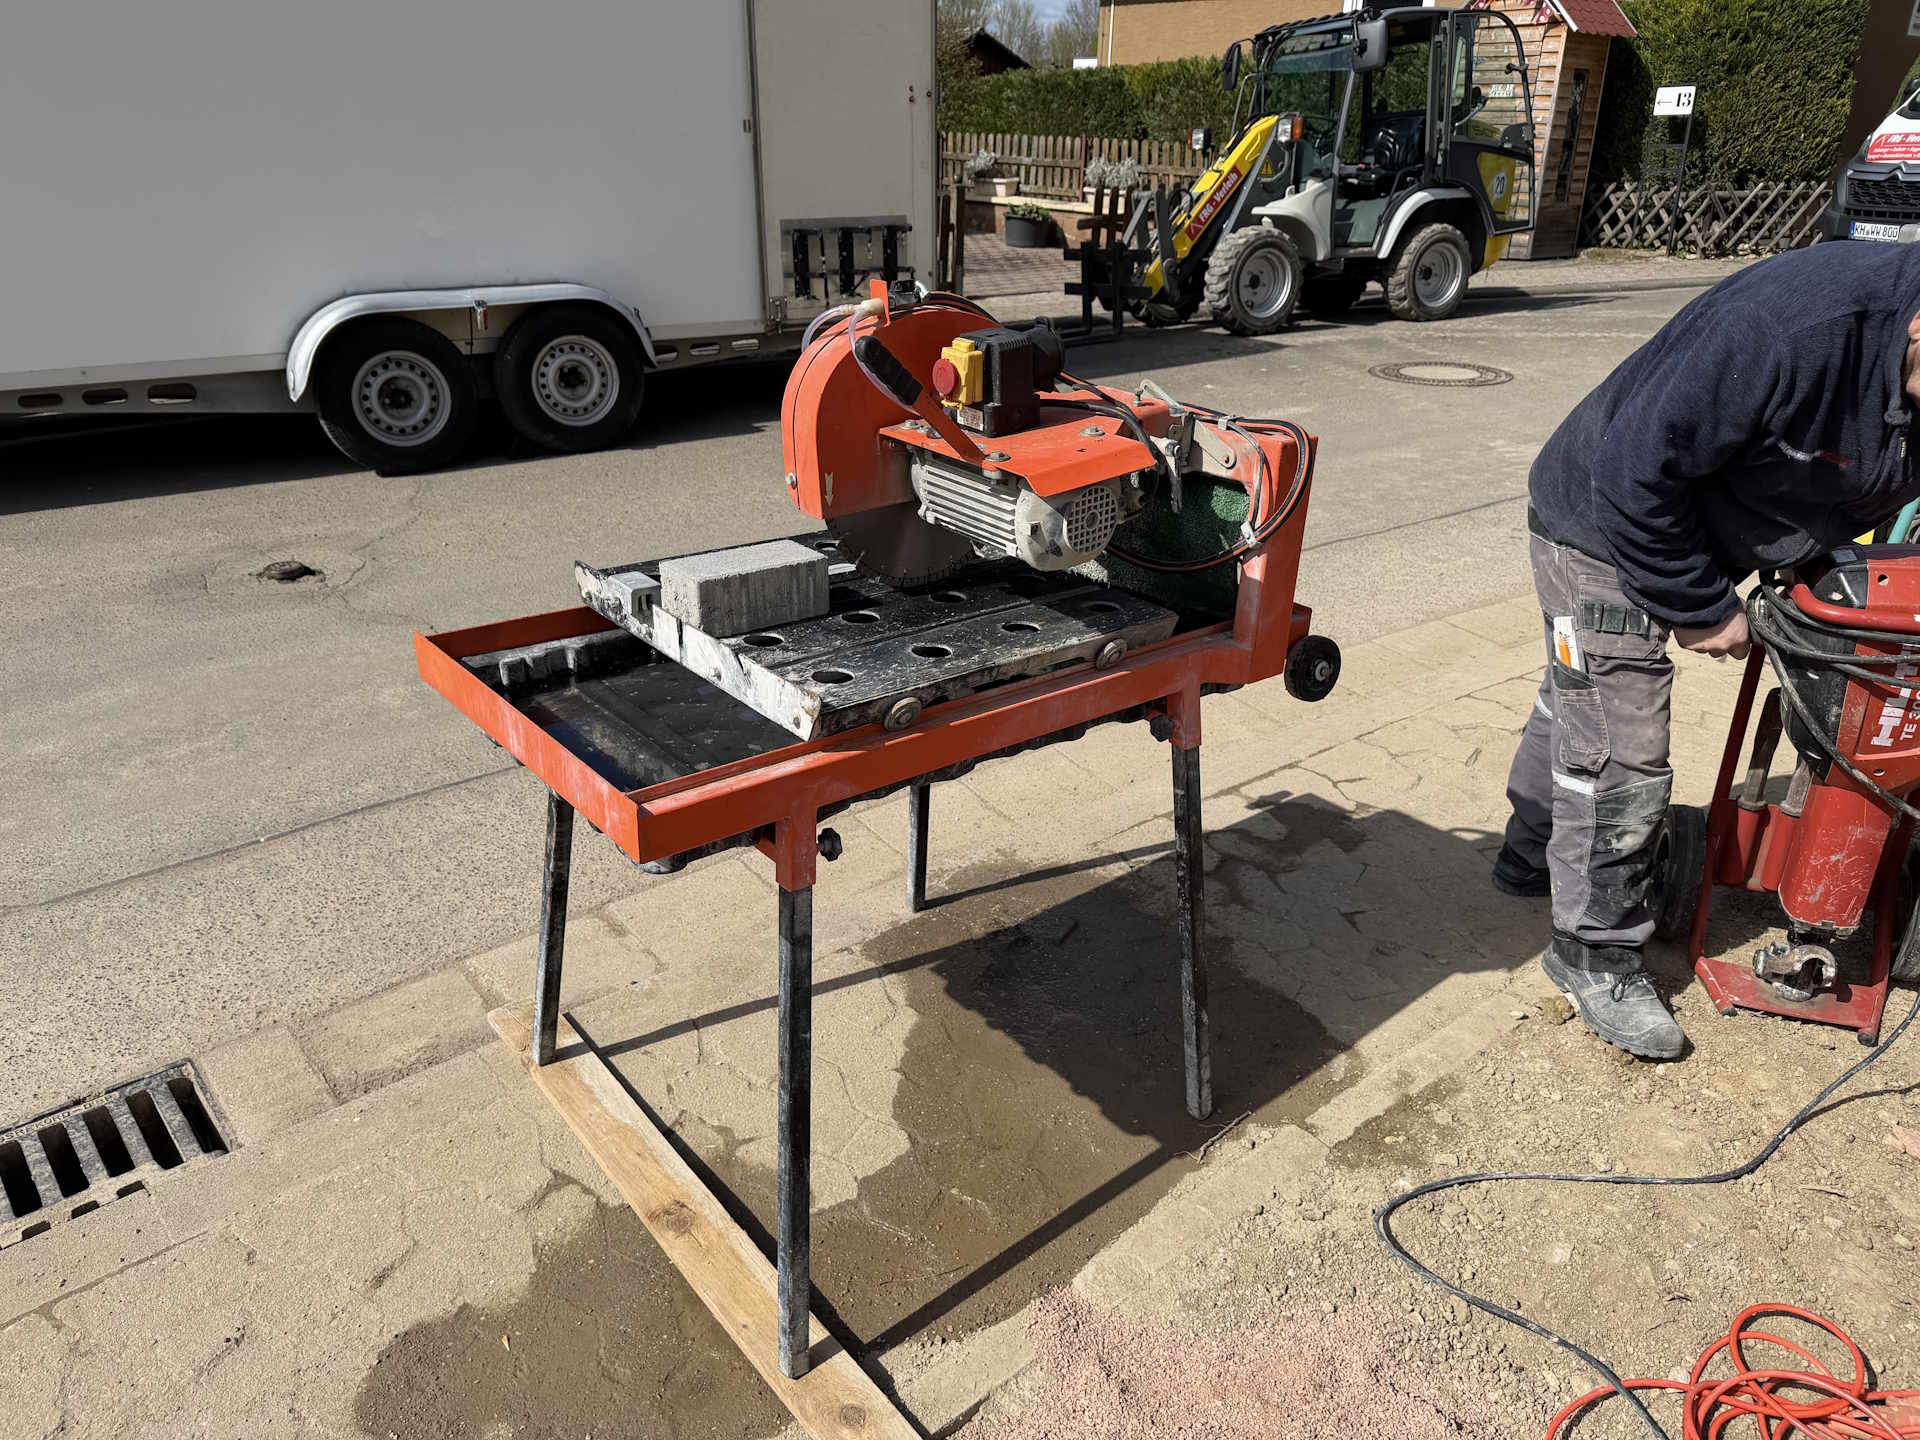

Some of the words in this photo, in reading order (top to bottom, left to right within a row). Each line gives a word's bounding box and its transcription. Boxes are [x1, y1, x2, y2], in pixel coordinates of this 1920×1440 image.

[1676, 92, 1692, 107] 13
[1198, 203, 1214, 222] FRG
[1213, 172, 1238, 202] Verleih
[1900, 723, 1917, 740] TE
